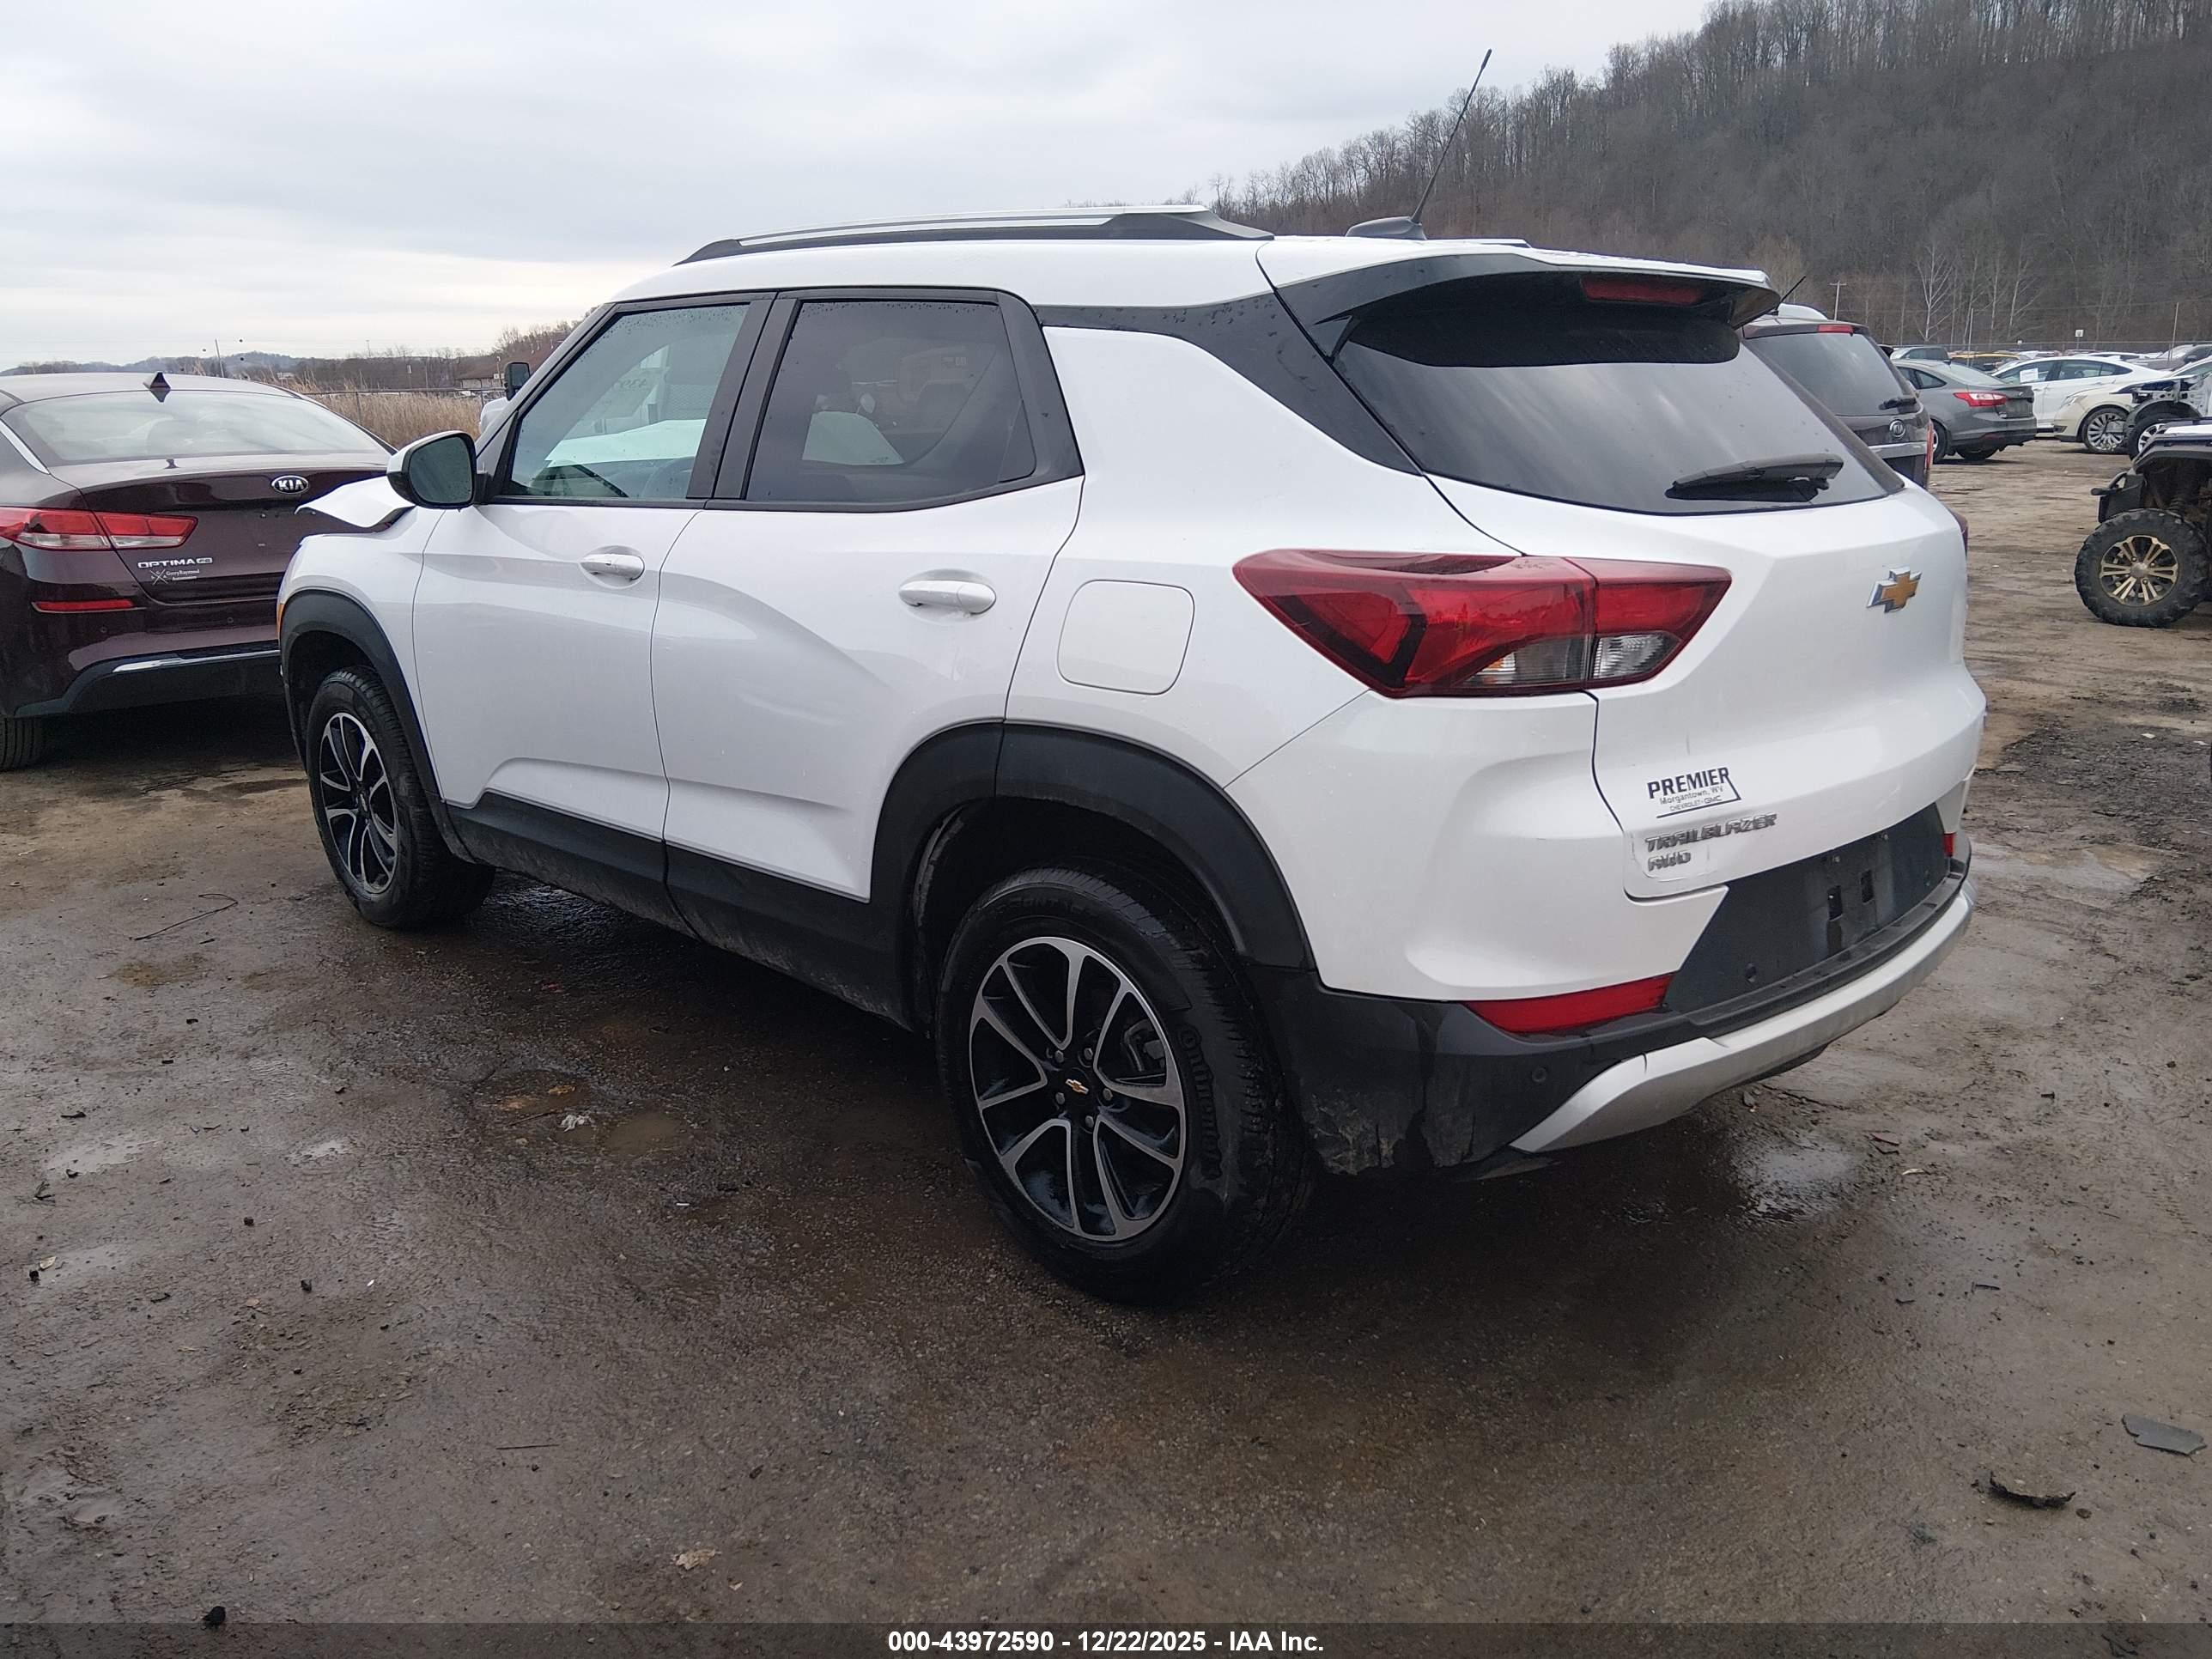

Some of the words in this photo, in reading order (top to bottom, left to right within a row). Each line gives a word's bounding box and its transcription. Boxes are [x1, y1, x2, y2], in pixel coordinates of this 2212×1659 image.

[277, 479, 305, 490] KIA
[137, 558, 196, 568] OPTIMA
[1647, 767, 1729, 799] PREMIER
[1645, 813, 1777, 852] TRAILBLAZER
[1648, 850, 1692, 872] AWD
